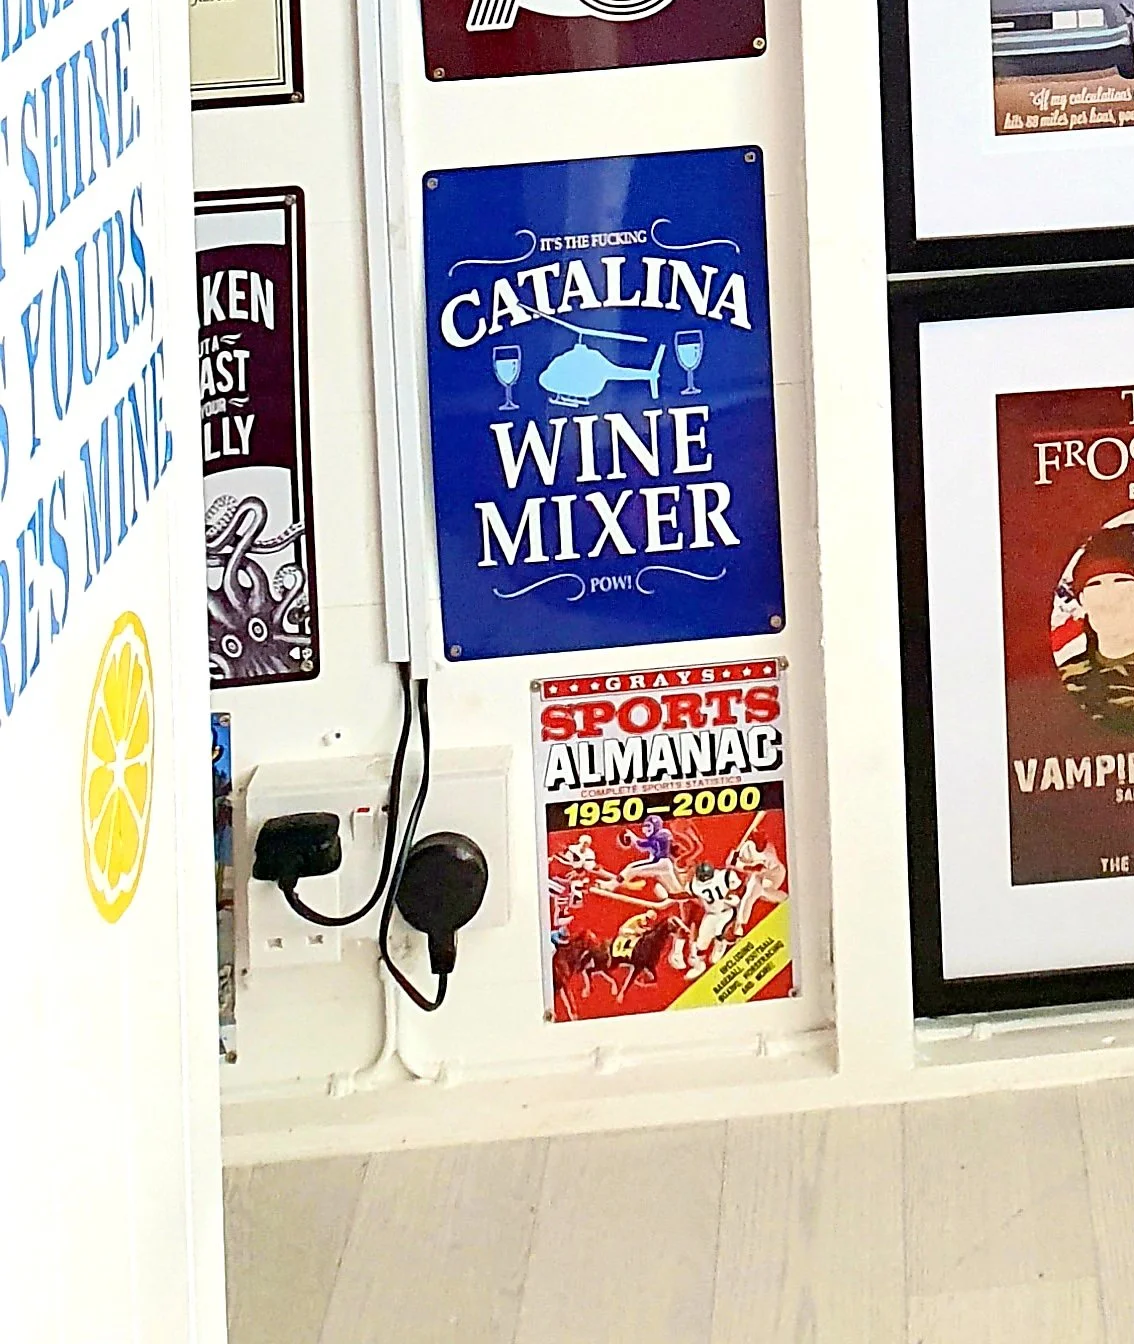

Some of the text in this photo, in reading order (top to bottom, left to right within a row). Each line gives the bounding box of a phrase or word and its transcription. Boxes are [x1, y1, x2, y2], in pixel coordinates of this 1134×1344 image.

[539, 229, 648, 253] IT'S THE FUCKING
[441, 256, 753, 349] CATALINA
[490, 406, 713, 489] WINE
[475, 482, 740, 568] MIXER
[590, 575, 633, 594] POW!
[605, 667, 716, 691] GRAYS
[541, 685, 781, 742] SPORTS
[544, 724, 783, 792] ALMANAC
[580, 775, 742, 798] COMPLETE SPORTS STATISTICS
[1100, 855, 1129, 873] THE
[702, 885, 724, 905] 31
